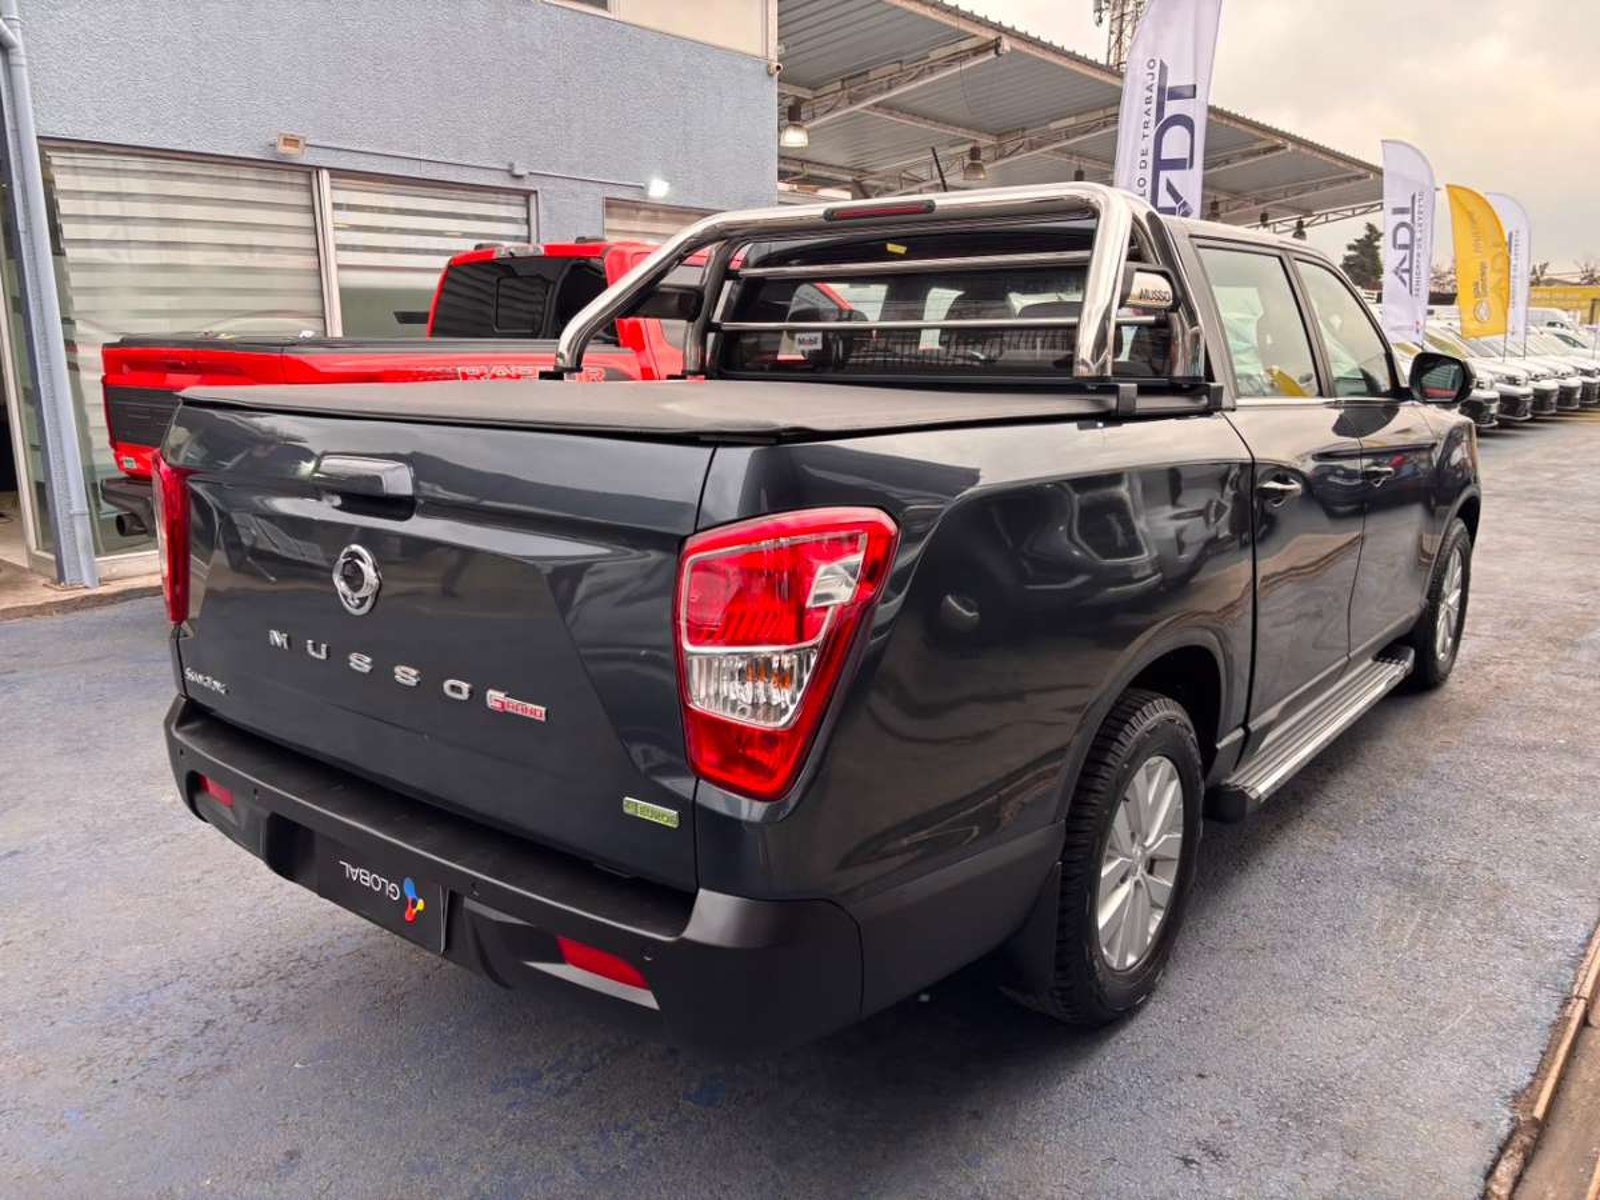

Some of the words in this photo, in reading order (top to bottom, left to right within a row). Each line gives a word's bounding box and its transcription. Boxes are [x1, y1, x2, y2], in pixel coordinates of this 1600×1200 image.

[1142, 58, 1157, 141] TRABAJO
[1139, 149, 1149, 170] DE
[268, 629, 473, 701] MUSSO
[486, 689, 546, 722] GRAND
[339, 860, 400, 901] GLOBAL
